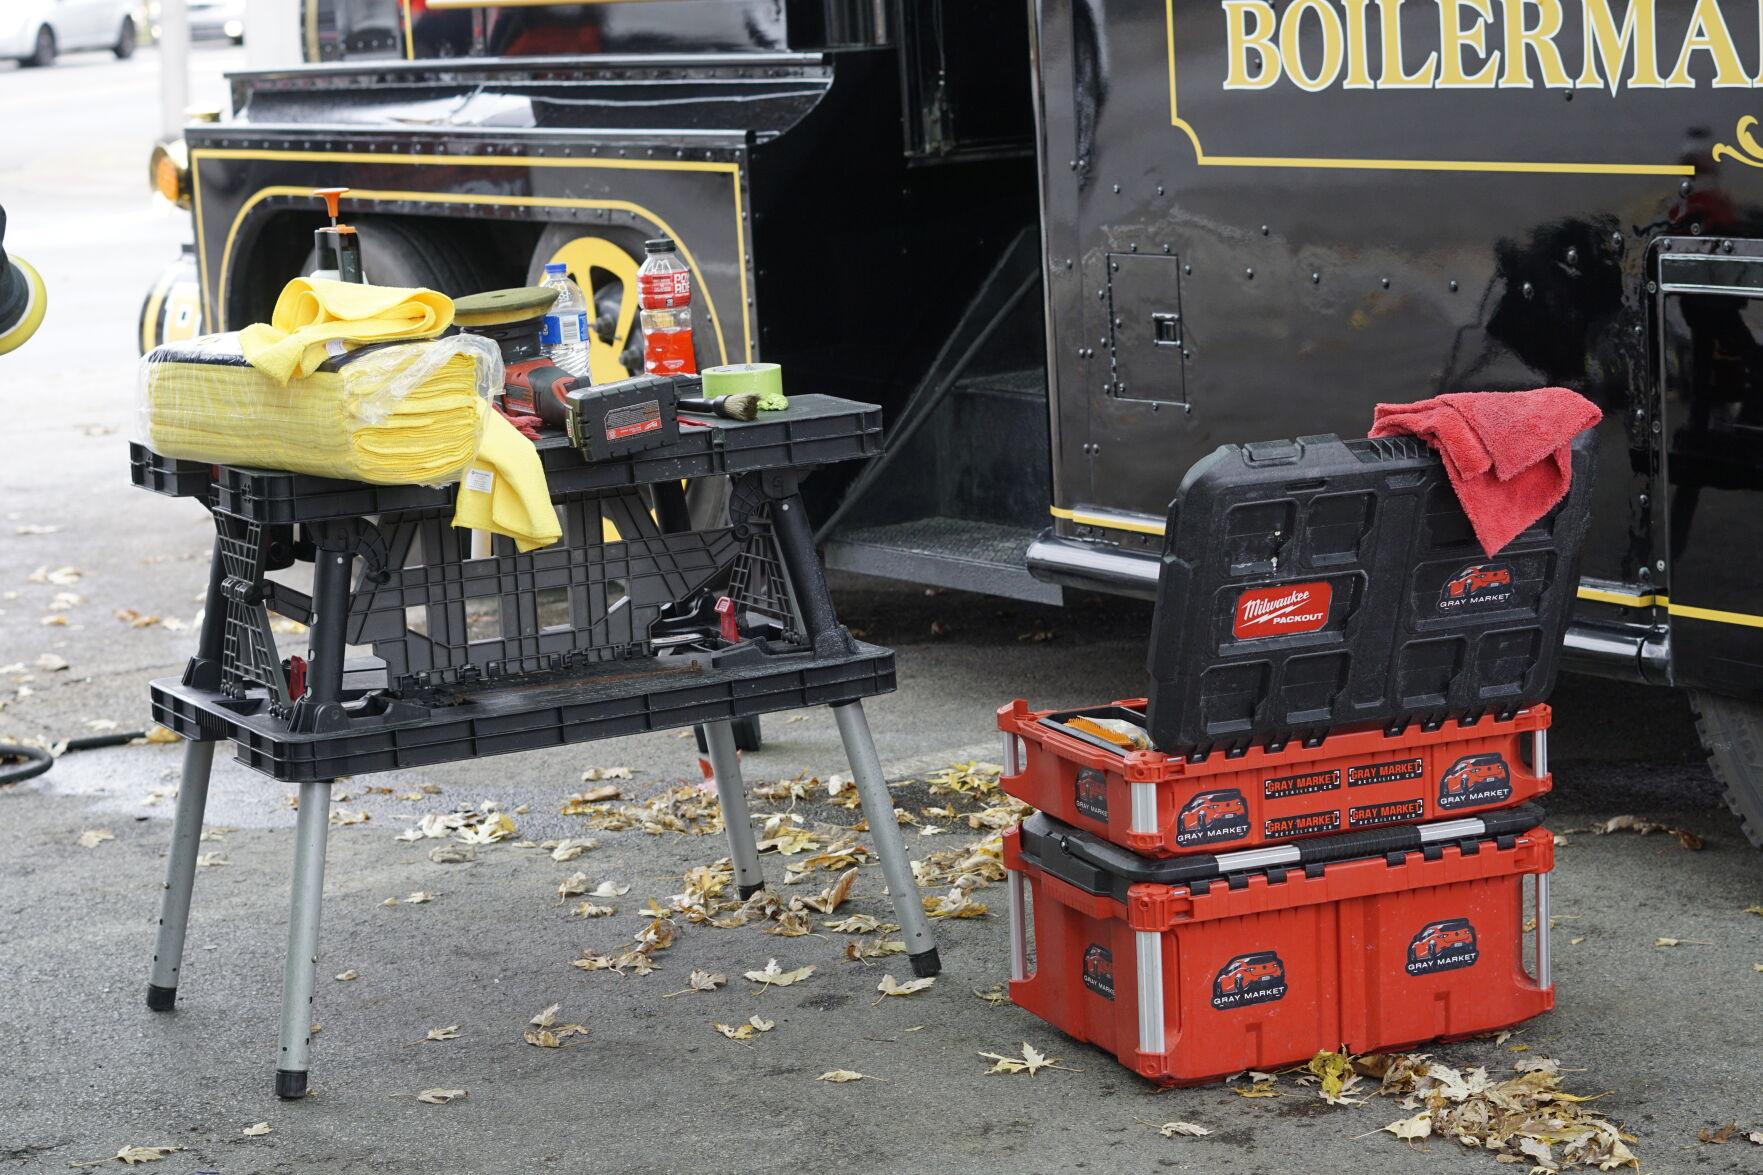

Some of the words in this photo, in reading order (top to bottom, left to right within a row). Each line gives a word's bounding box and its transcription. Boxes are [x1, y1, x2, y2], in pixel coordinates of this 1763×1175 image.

[1223, 0, 1763, 98] BOILERMA
[1242, 590, 1310, 620] Milwaukee
[1440, 598, 1467, 608] GRAY
[1470, 593, 1510, 604] MARKET
[1273, 612, 1324, 624] PACKOUT
[1352, 767, 1376, 779] GRAY
[1380, 762, 1419, 775] MARKET
[1268, 780, 1293, 792] GRAY
[1297, 773, 1337, 788] MARKET
[1358, 775, 1400, 784] DETAILING
[1275, 786, 1318, 797] DETAILING
[1440, 795, 1466, 804] GRAY
[1470, 788, 1510, 800] MARKET
[1076, 800, 1090, 810] GRAY
[1090, 805, 1108, 817] MARKE
[1353, 808, 1378, 820] GRAY
[1381, 802, 1420, 816] MARKET
[1268, 820, 1293, 832] GRAY
[1297, 813, 1337, 829] MARKET
[1359, 815, 1401, 825] DETAILING
[1177, 831, 1204, 842] GRAY
[1207, 825, 1249, 837] MARKET
[1275, 827, 1318, 837] DETAILING
[1408, 960, 1434, 971] GRAY
[1437, 953, 1477, 966] MARKET
[1083, 975, 1098, 986] GRAY
[1098, 982, 1115, 996] MARKE
[1213, 994, 1241, 1005] GRAY
[1244, 986, 1285, 1000] MARKET
